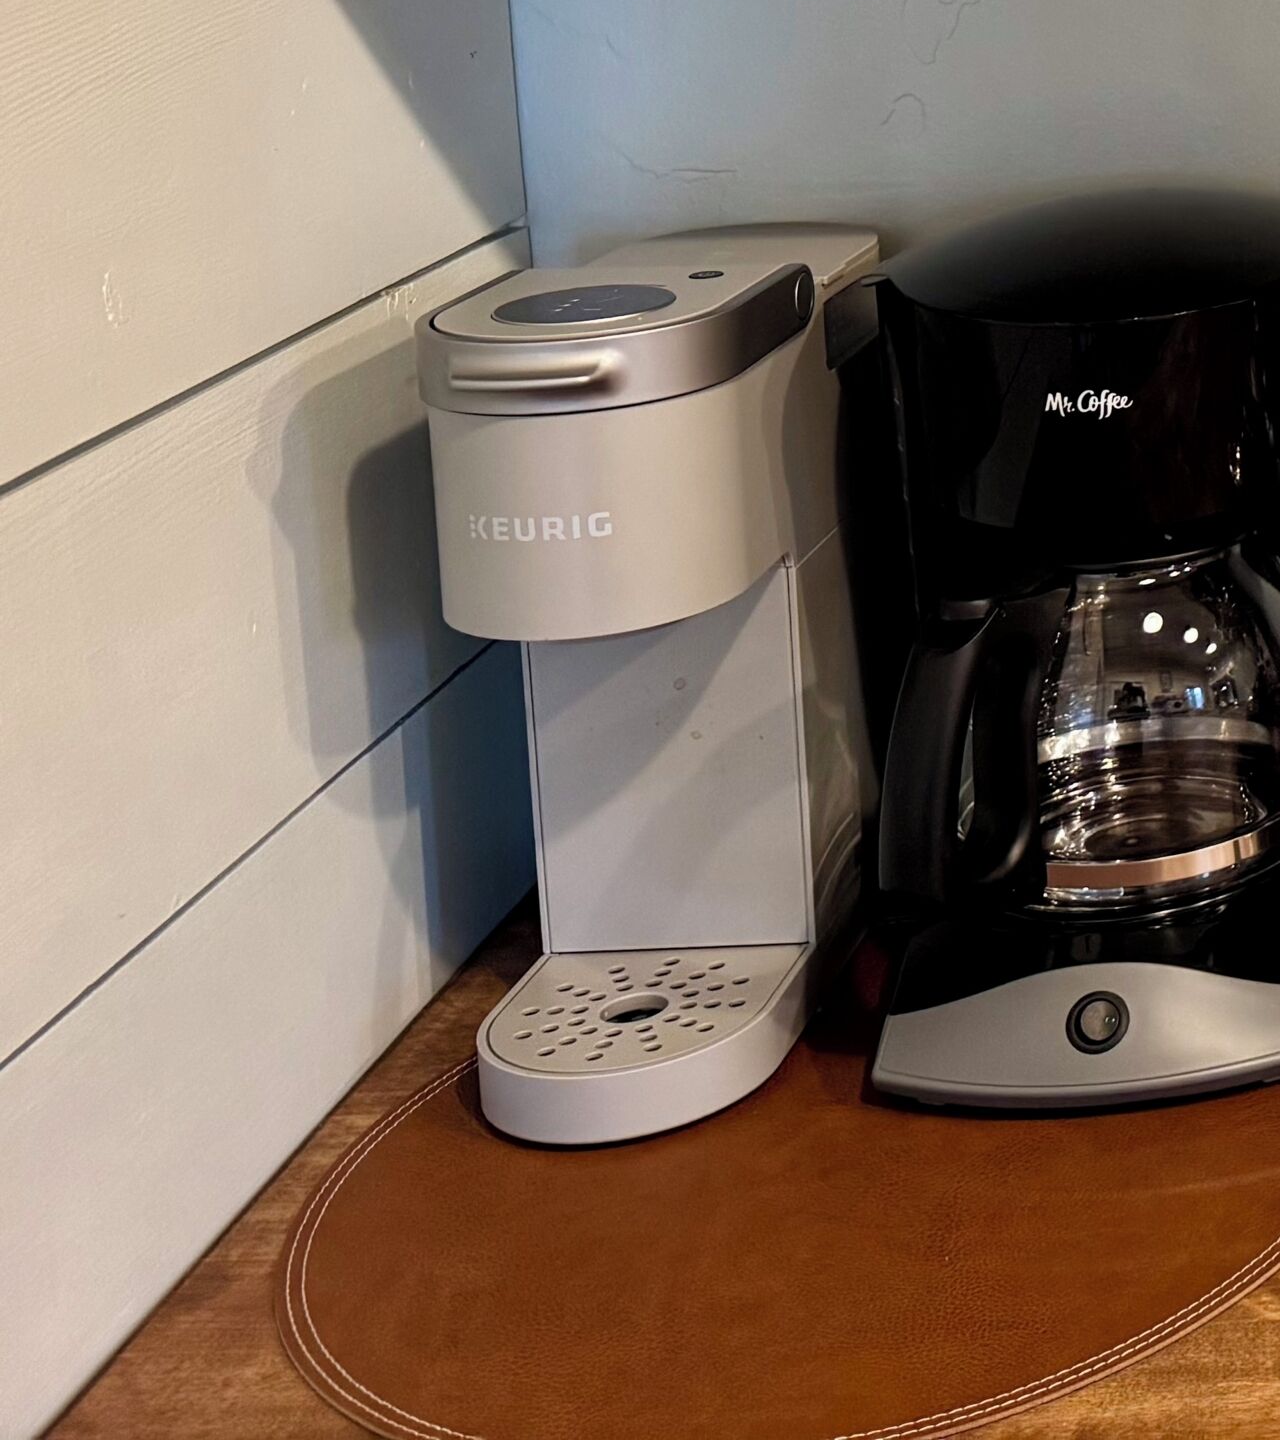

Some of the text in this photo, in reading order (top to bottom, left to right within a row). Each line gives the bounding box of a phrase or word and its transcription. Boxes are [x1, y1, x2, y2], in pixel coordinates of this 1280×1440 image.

[1045, 389, 1133, 420] Mr. Coffee
[469, 512, 613, 542] KEURIG
